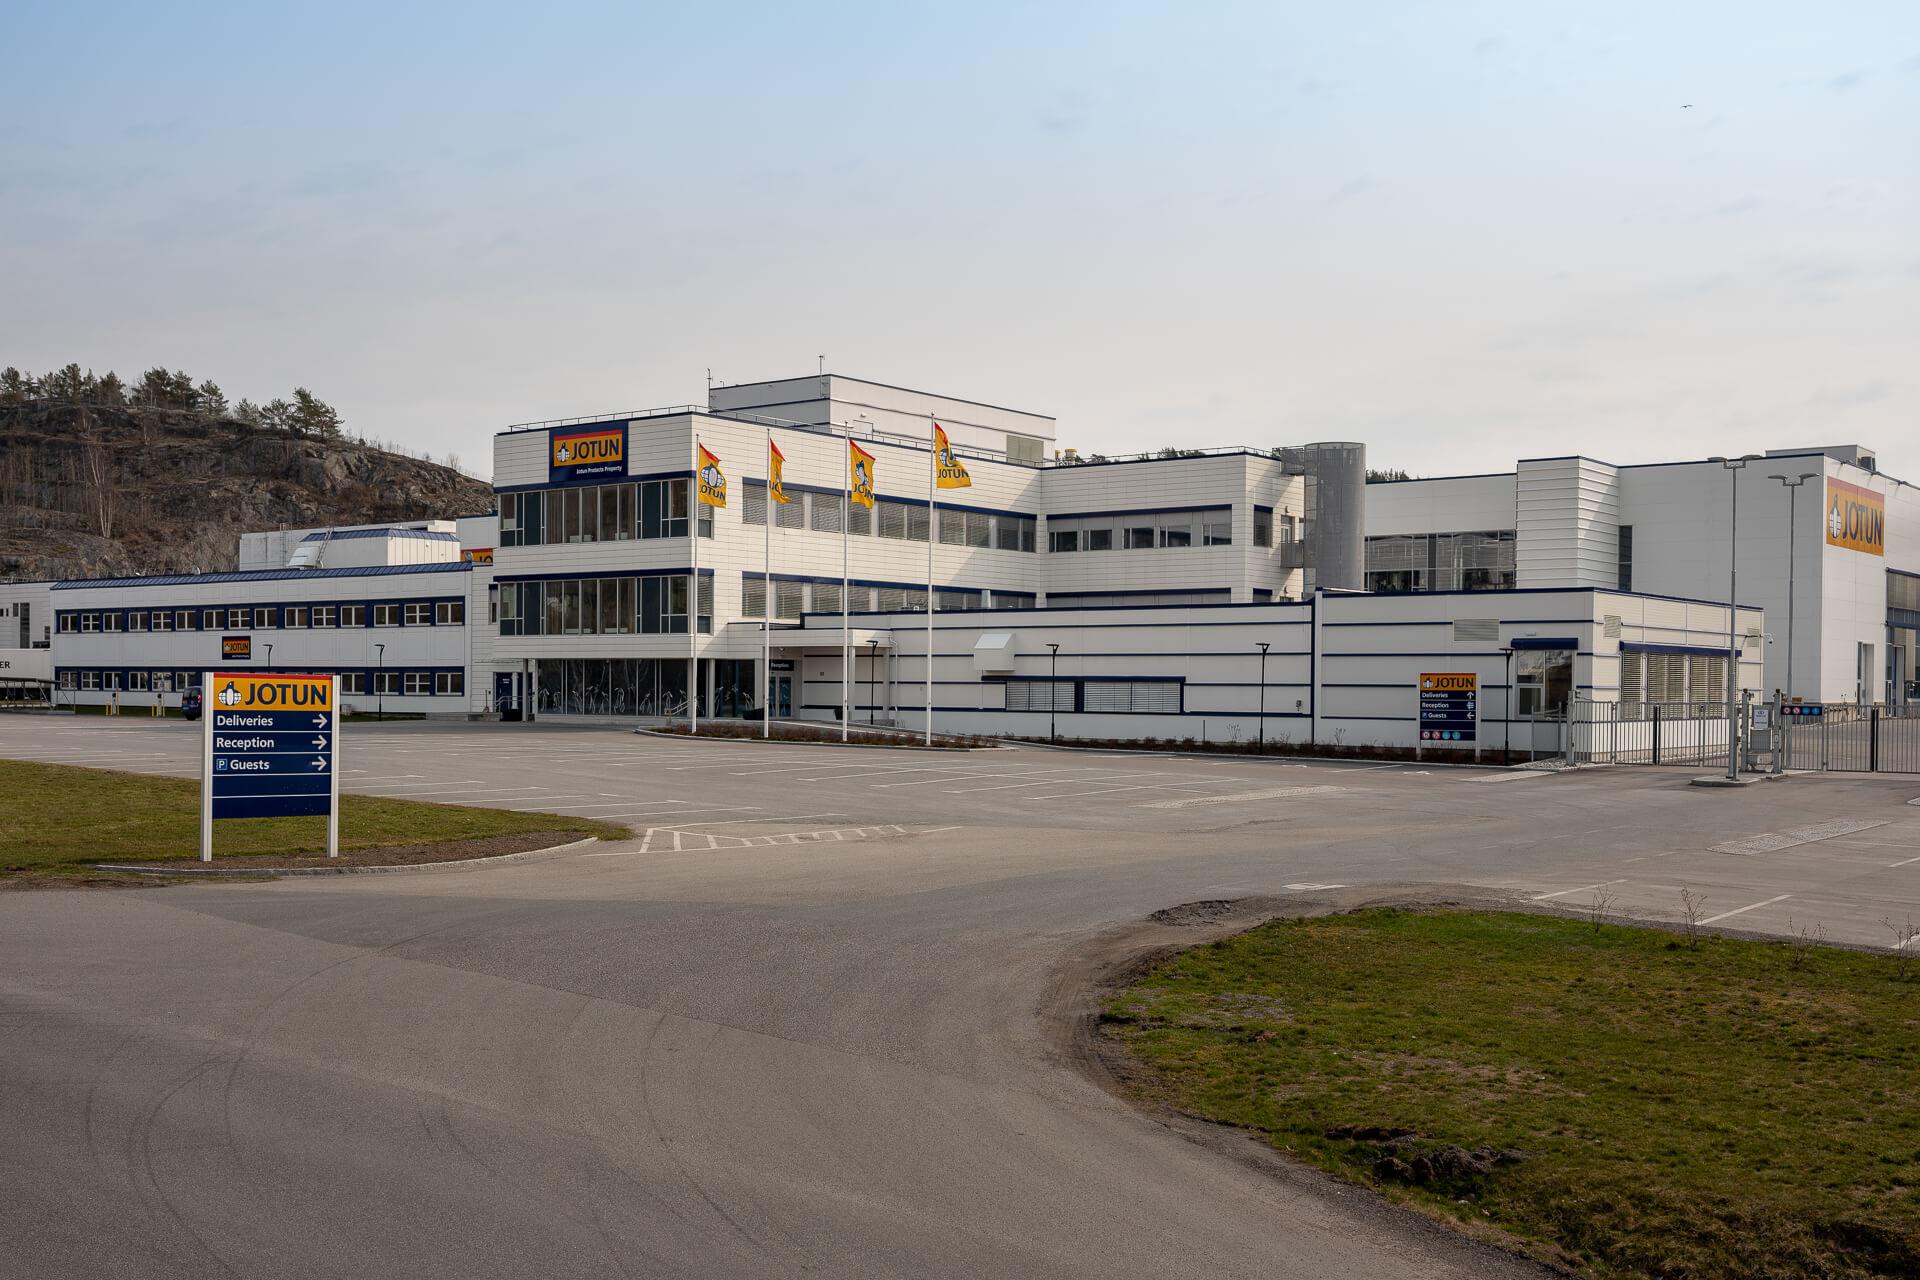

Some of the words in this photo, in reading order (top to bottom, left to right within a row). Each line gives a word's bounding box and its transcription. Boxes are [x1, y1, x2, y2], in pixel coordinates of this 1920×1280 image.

[571, 438, 619, 460] JOTUN
[937, 468, 970, 479] JOTUN
[1842, 499, 1883, 546] JOTUN
[230, 642, 249, 651] JOTUN
[1434, 677, 1474, 688] JOTUN
[245, 683, 327, 705] JOTUN
[216, 715, 273, 727] Deliveries
[216, 737, 275, 751] Reception
[230, 759, 270, 770] Guests
